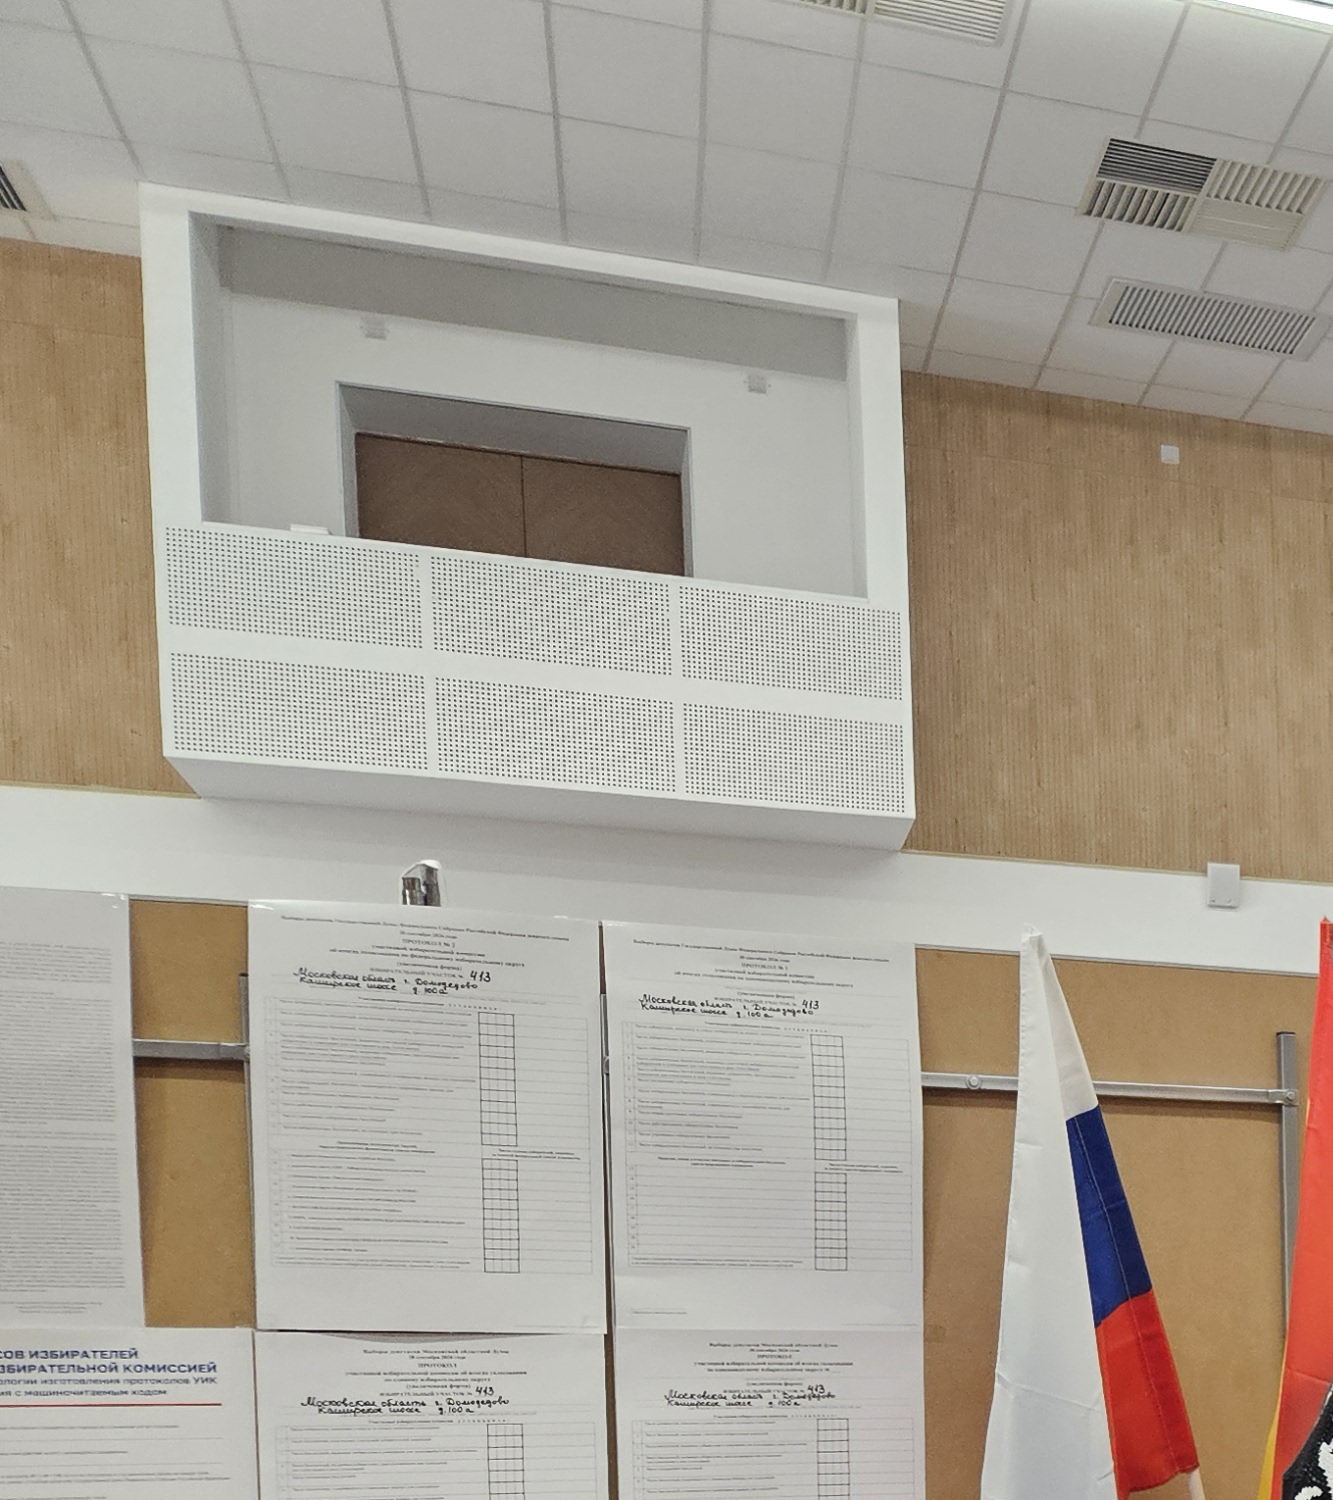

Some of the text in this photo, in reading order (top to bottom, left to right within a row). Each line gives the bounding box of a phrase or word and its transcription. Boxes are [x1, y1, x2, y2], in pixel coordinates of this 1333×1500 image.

[470, 970, 492, 983] 413
[802, 999, 820, 1010] 413
[29, 1348, 139, 1360] ИЗБИРАТЕЛЕЙ
[123, 1362, 217, 1374] КОМИССИЕЙ
[193, 1376, 218, 1385] УИК
[475, 1386, 495, 1397] 413
